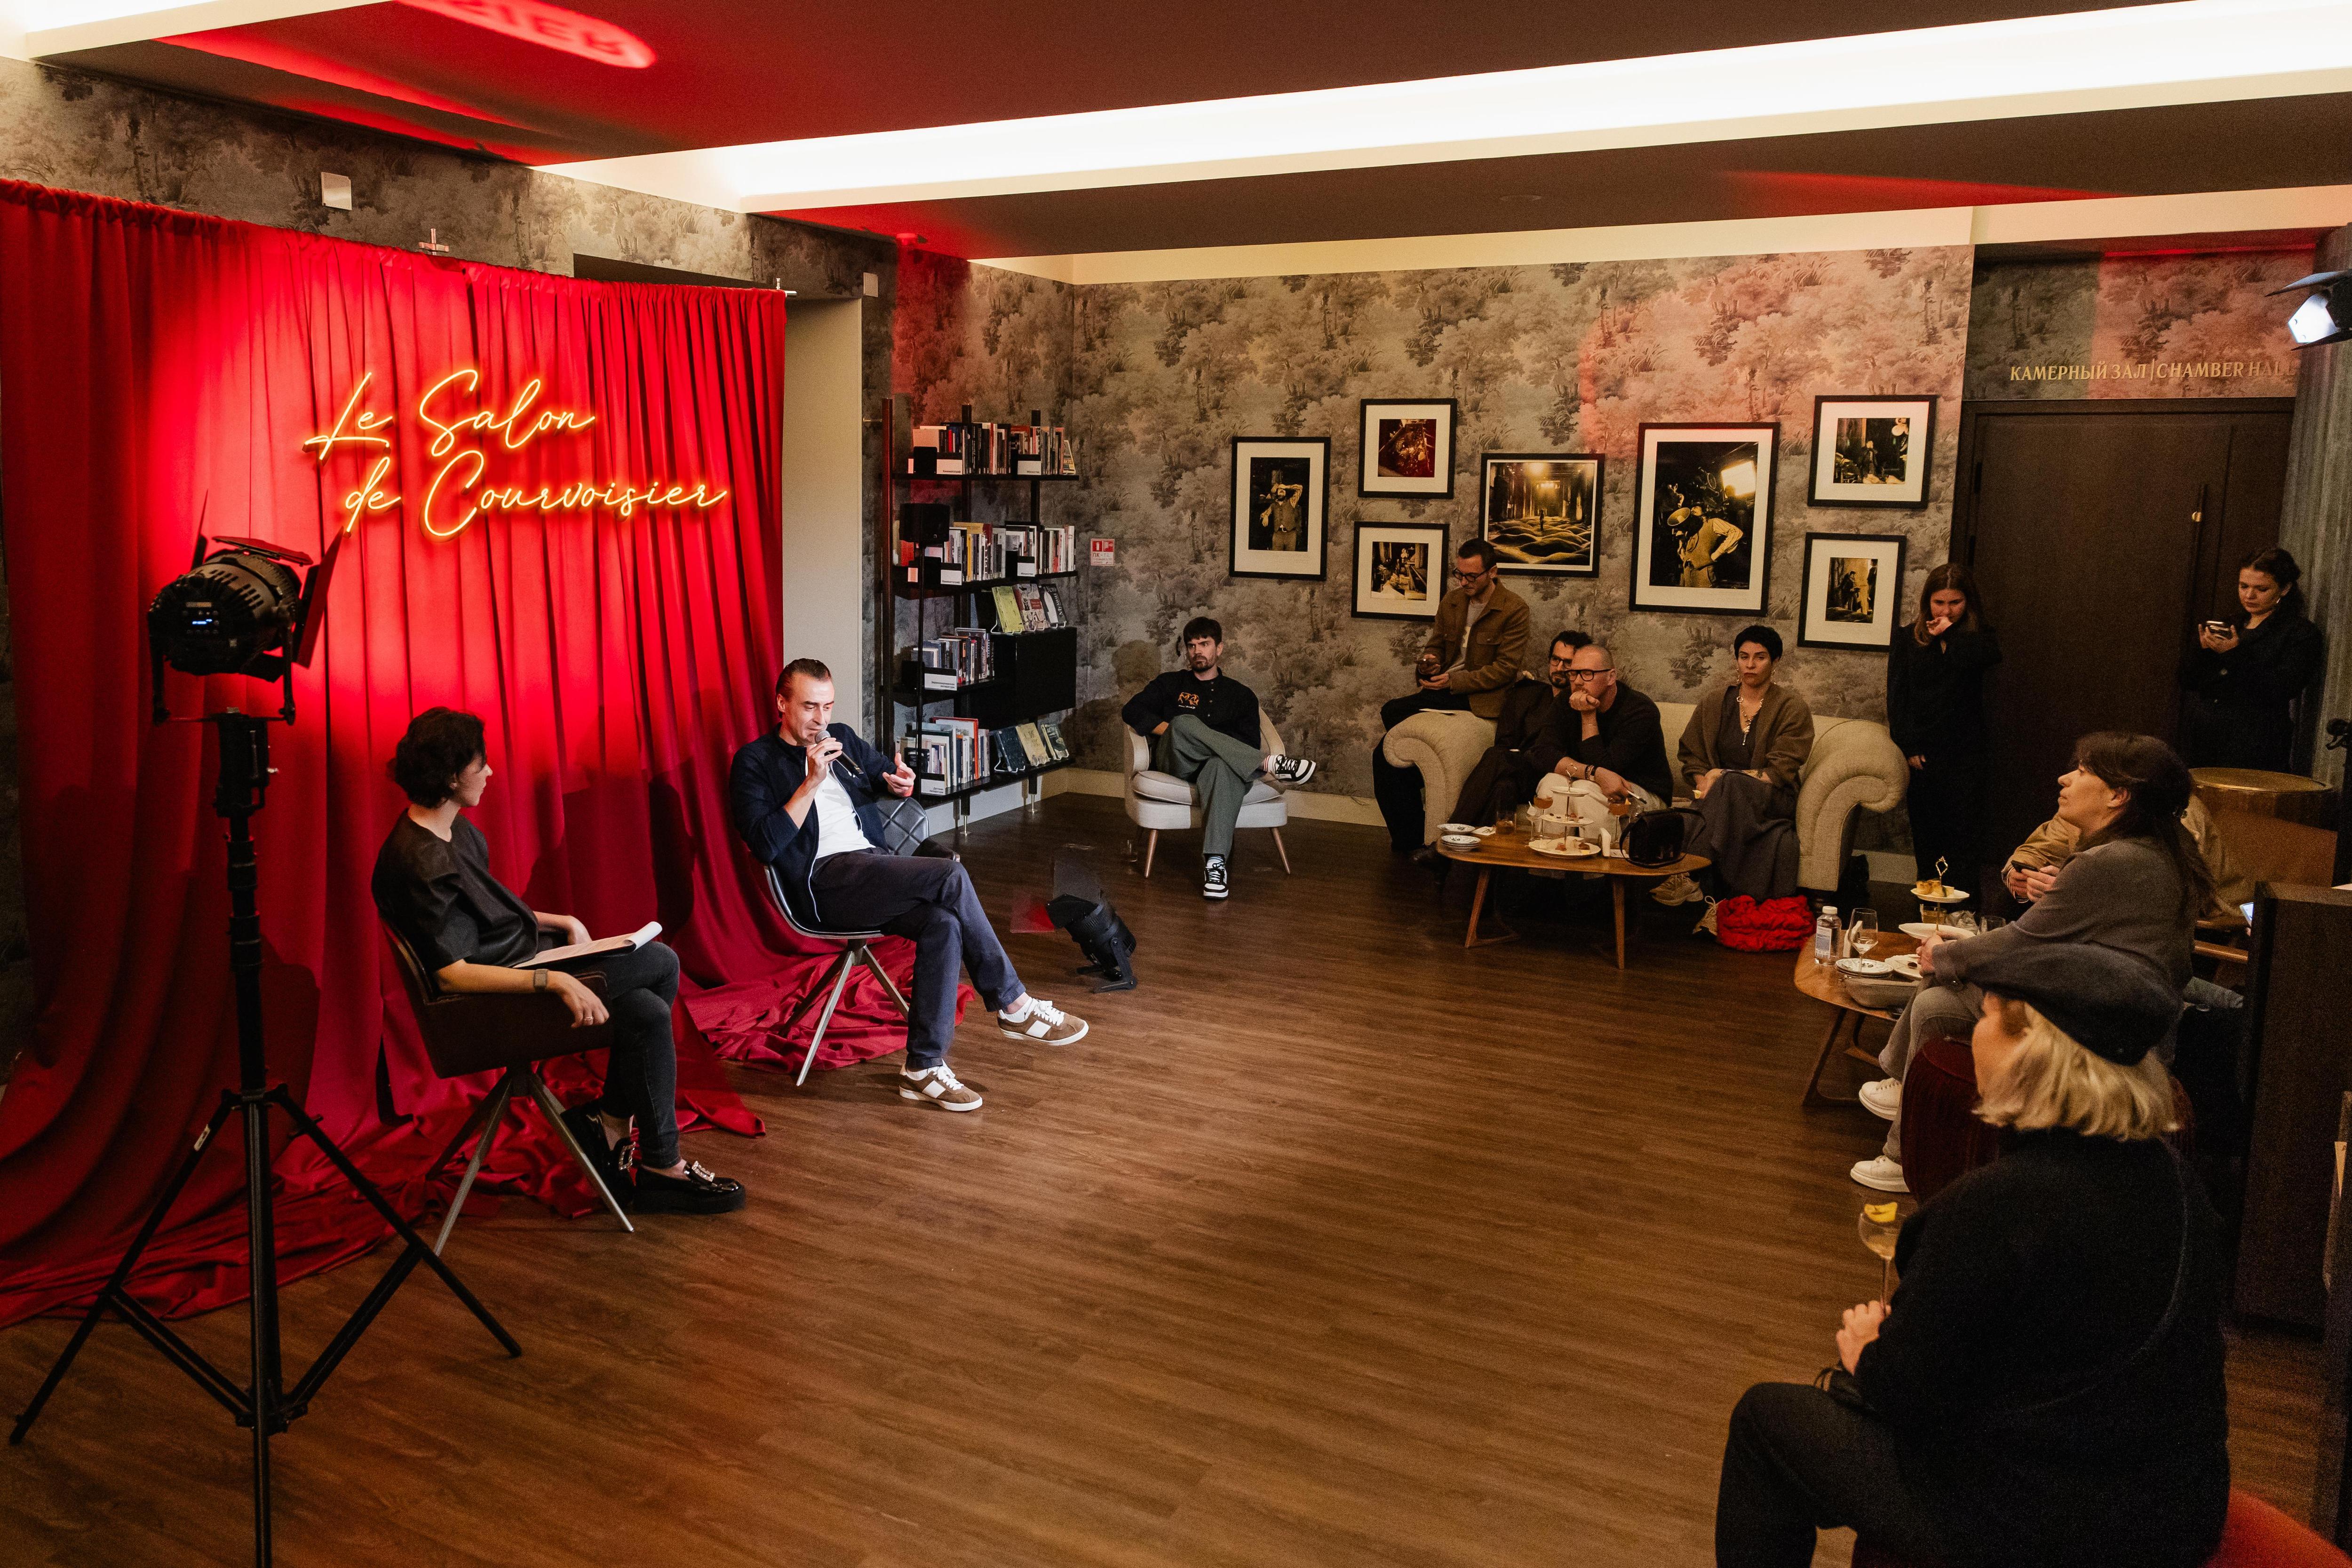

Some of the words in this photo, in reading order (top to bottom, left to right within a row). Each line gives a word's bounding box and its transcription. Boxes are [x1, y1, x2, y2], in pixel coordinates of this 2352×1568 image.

[2010, 361, 2108, 381] КАМЕРНЫЙ
[2111, 363, 2147, 380] ЗАЛ
[2156, 362, 2245, 379] CHAMBER
[303, 372, 393, 461] Le
[419, 369, 596, 457] Salon
[344, 456, 402, 533] de
[424, 449, 727, 537] Courvoisier
